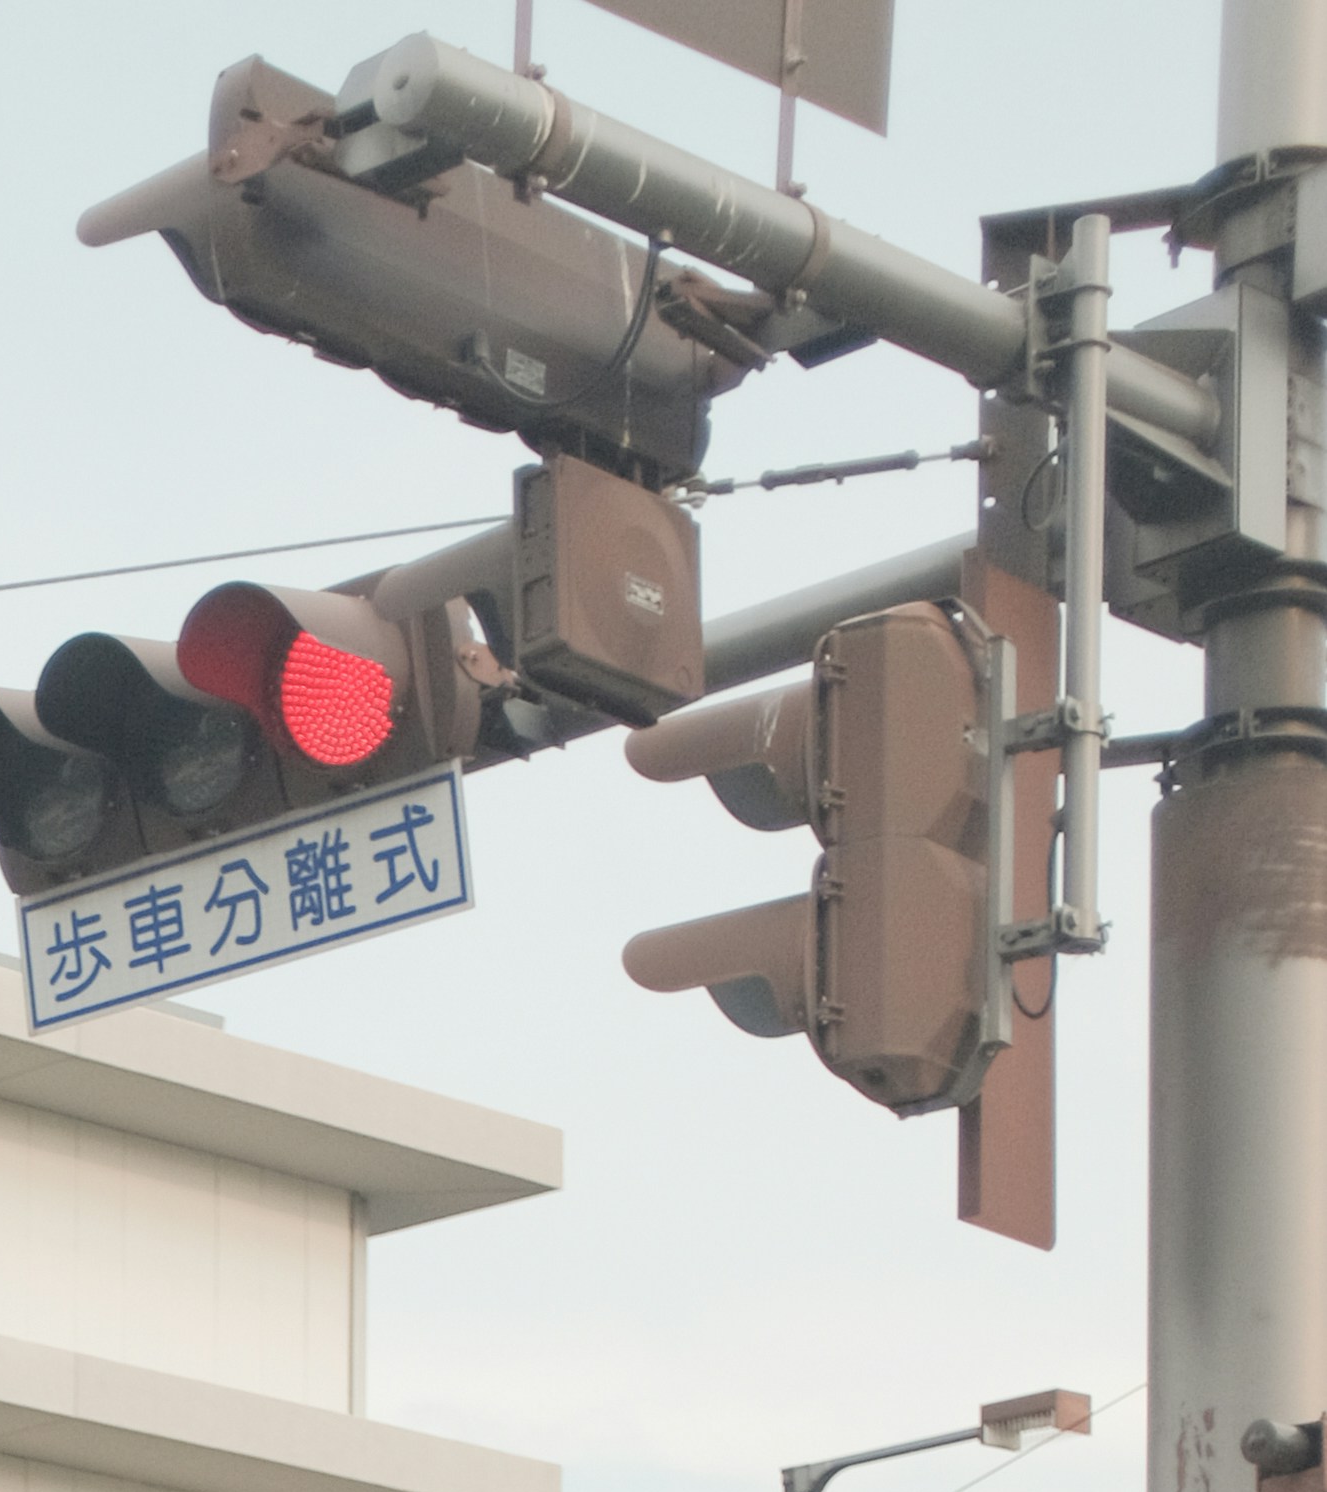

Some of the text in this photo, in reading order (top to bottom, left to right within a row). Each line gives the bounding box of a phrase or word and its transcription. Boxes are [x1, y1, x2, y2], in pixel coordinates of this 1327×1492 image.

[46, 804, 439, 1002] 歩車分離式
